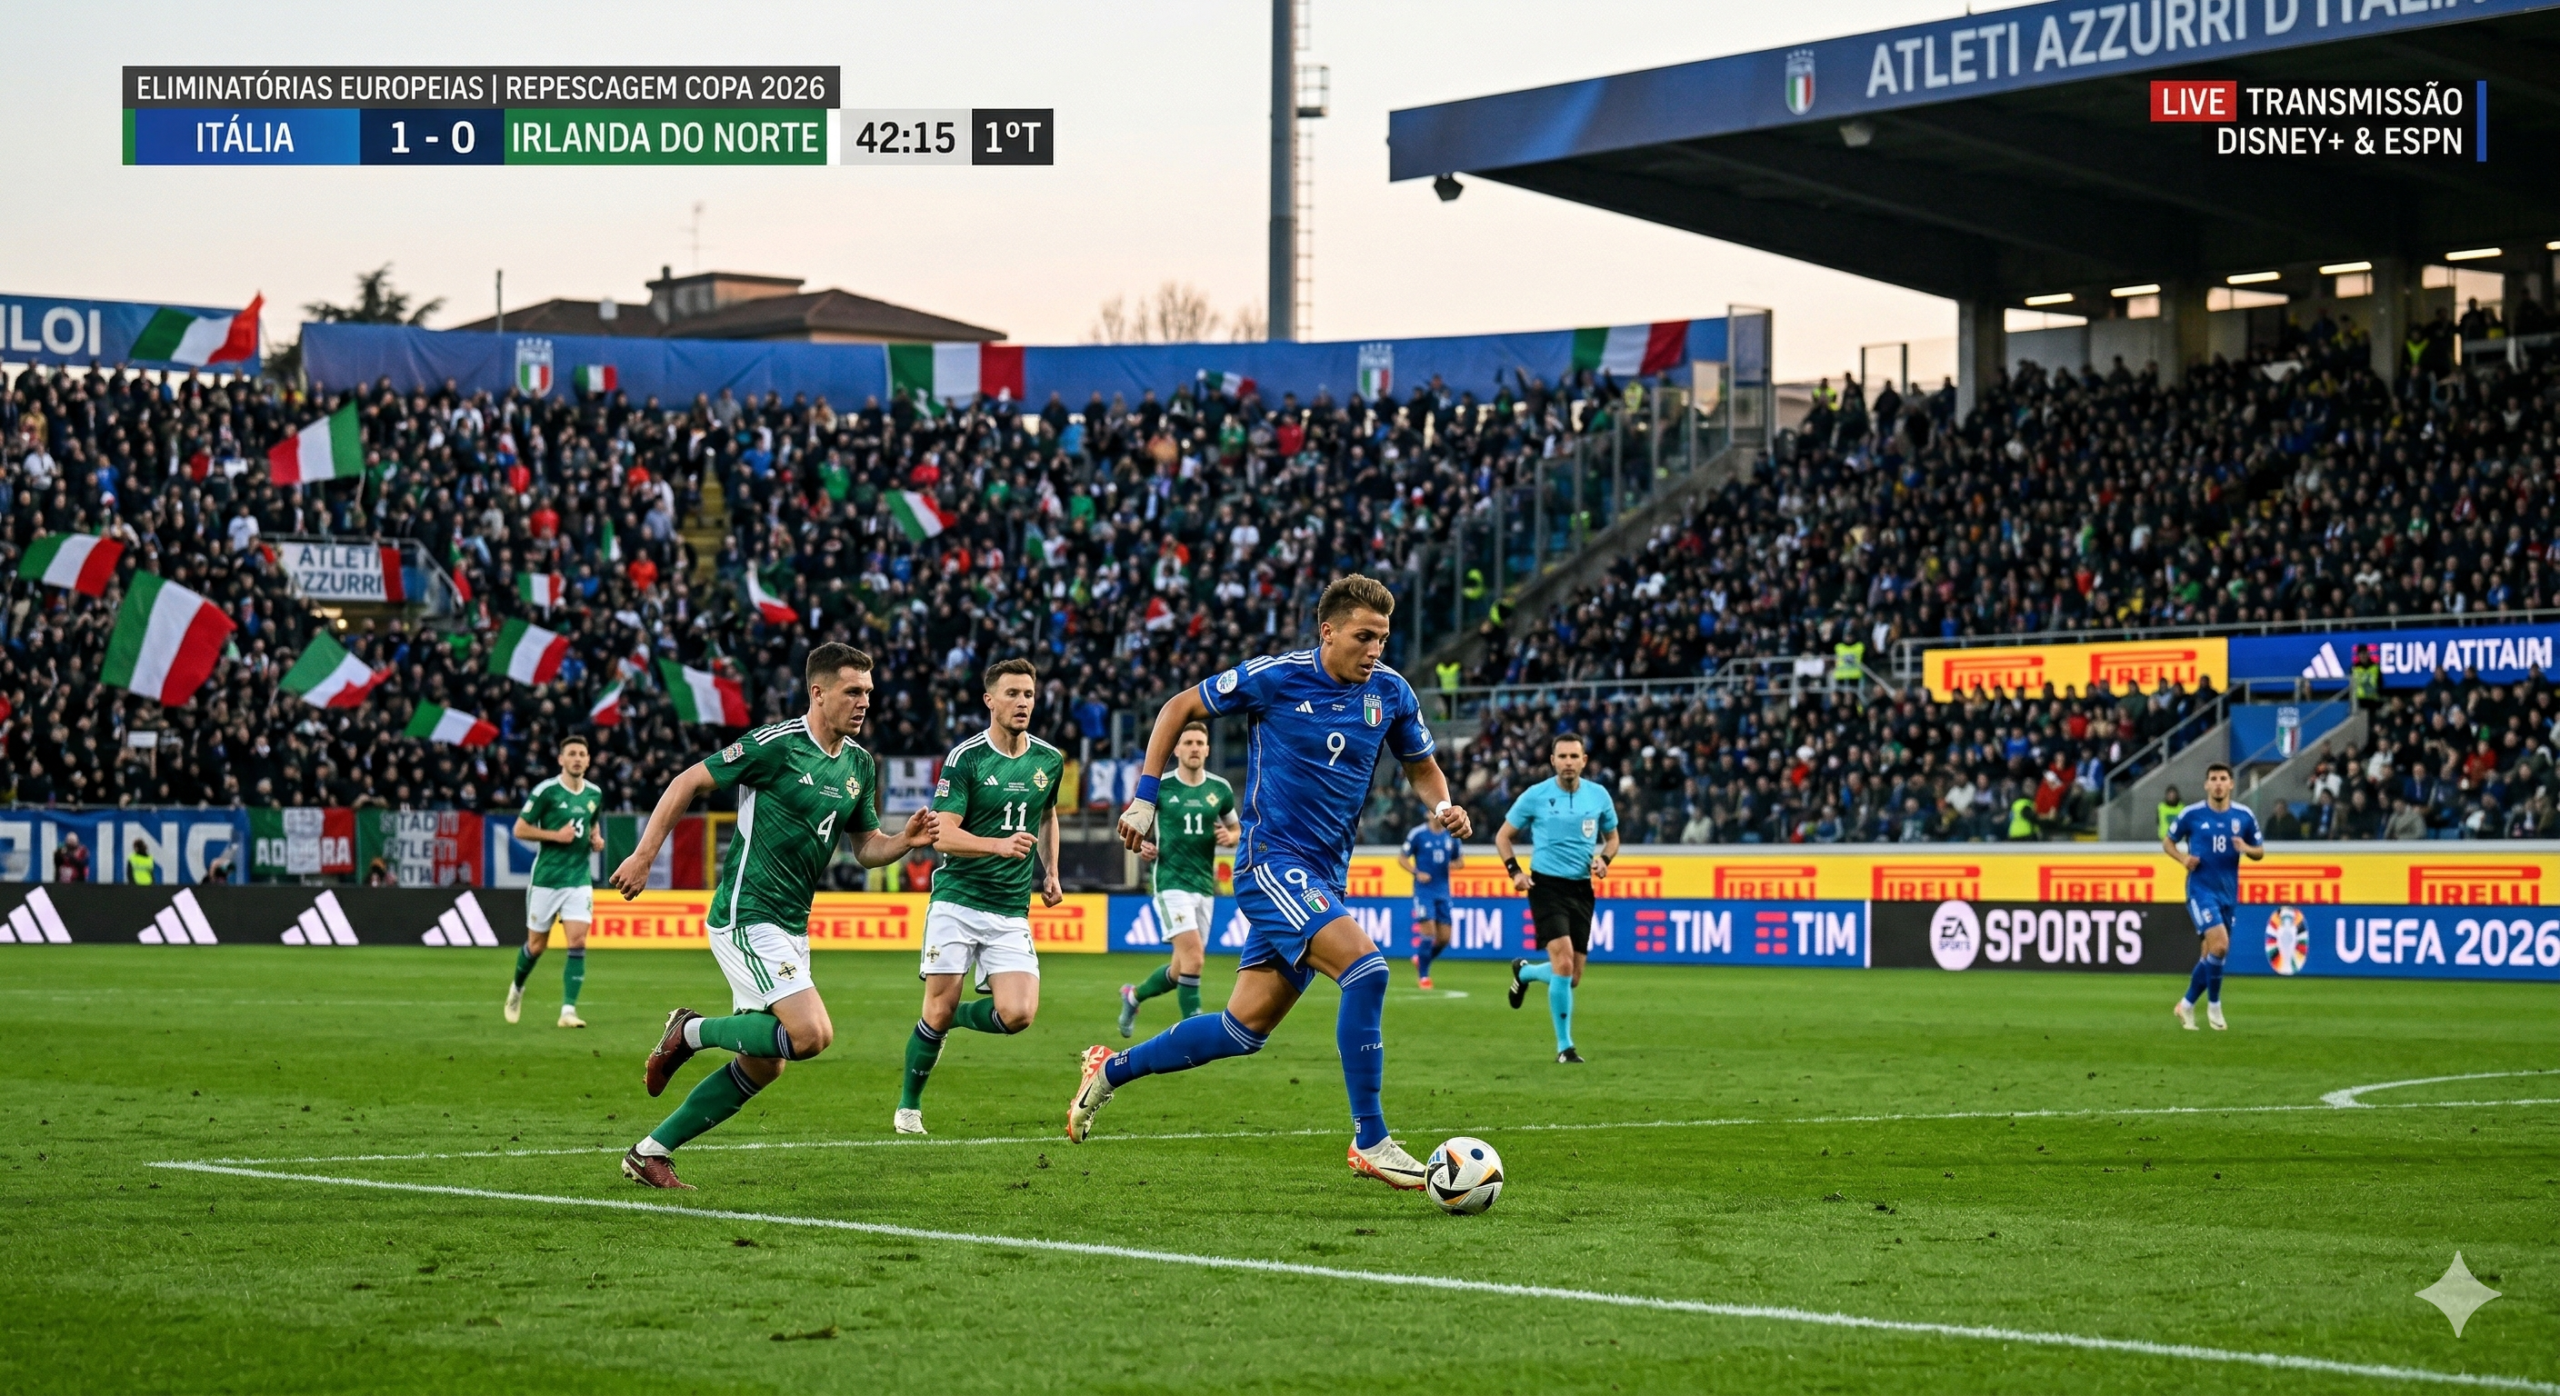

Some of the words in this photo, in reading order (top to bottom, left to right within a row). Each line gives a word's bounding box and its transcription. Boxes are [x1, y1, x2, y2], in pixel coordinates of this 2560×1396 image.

[1866, 22, 2019, 97] ATLETI
[2034, 0, 2246, 72] AZZURRI
[299, 545, 379, 569] ATLETI
[2090, 650, 2197, 688] PIRELLI
[2379, 641, 2438, 675] EUM
[1326, 732, 1346, 766] 9
[817, 810, 838, 843] 4
[1001, 801, 1027, 831] 11
[1183, 812, 1204, 835] 11
[2212, 834, 2227, 854] 18
[1284, 868, 1308, 890] 9
[1713, 865, 1817, 899] PIRELLI
[1871, 865, 1981, 901] PIRELLI
[2038, 865, 2155, 902] PIRELLI
[2238, 865, 2342, 903] IRELLI
[2408, 865, 2542, 905] PIRELLI
[590, 903, 707, 937] IRELLI
[1450, 908, 1502, 950] TIM
[1669, 910, 1732, 954] TIM
[1792, 911, 1857, 956] TIM
[1985, 909, 2142, 964] SPORTS
[2335, 918, 2446, 964] UEFA
[2455, 919, 2560, 967] 2026
